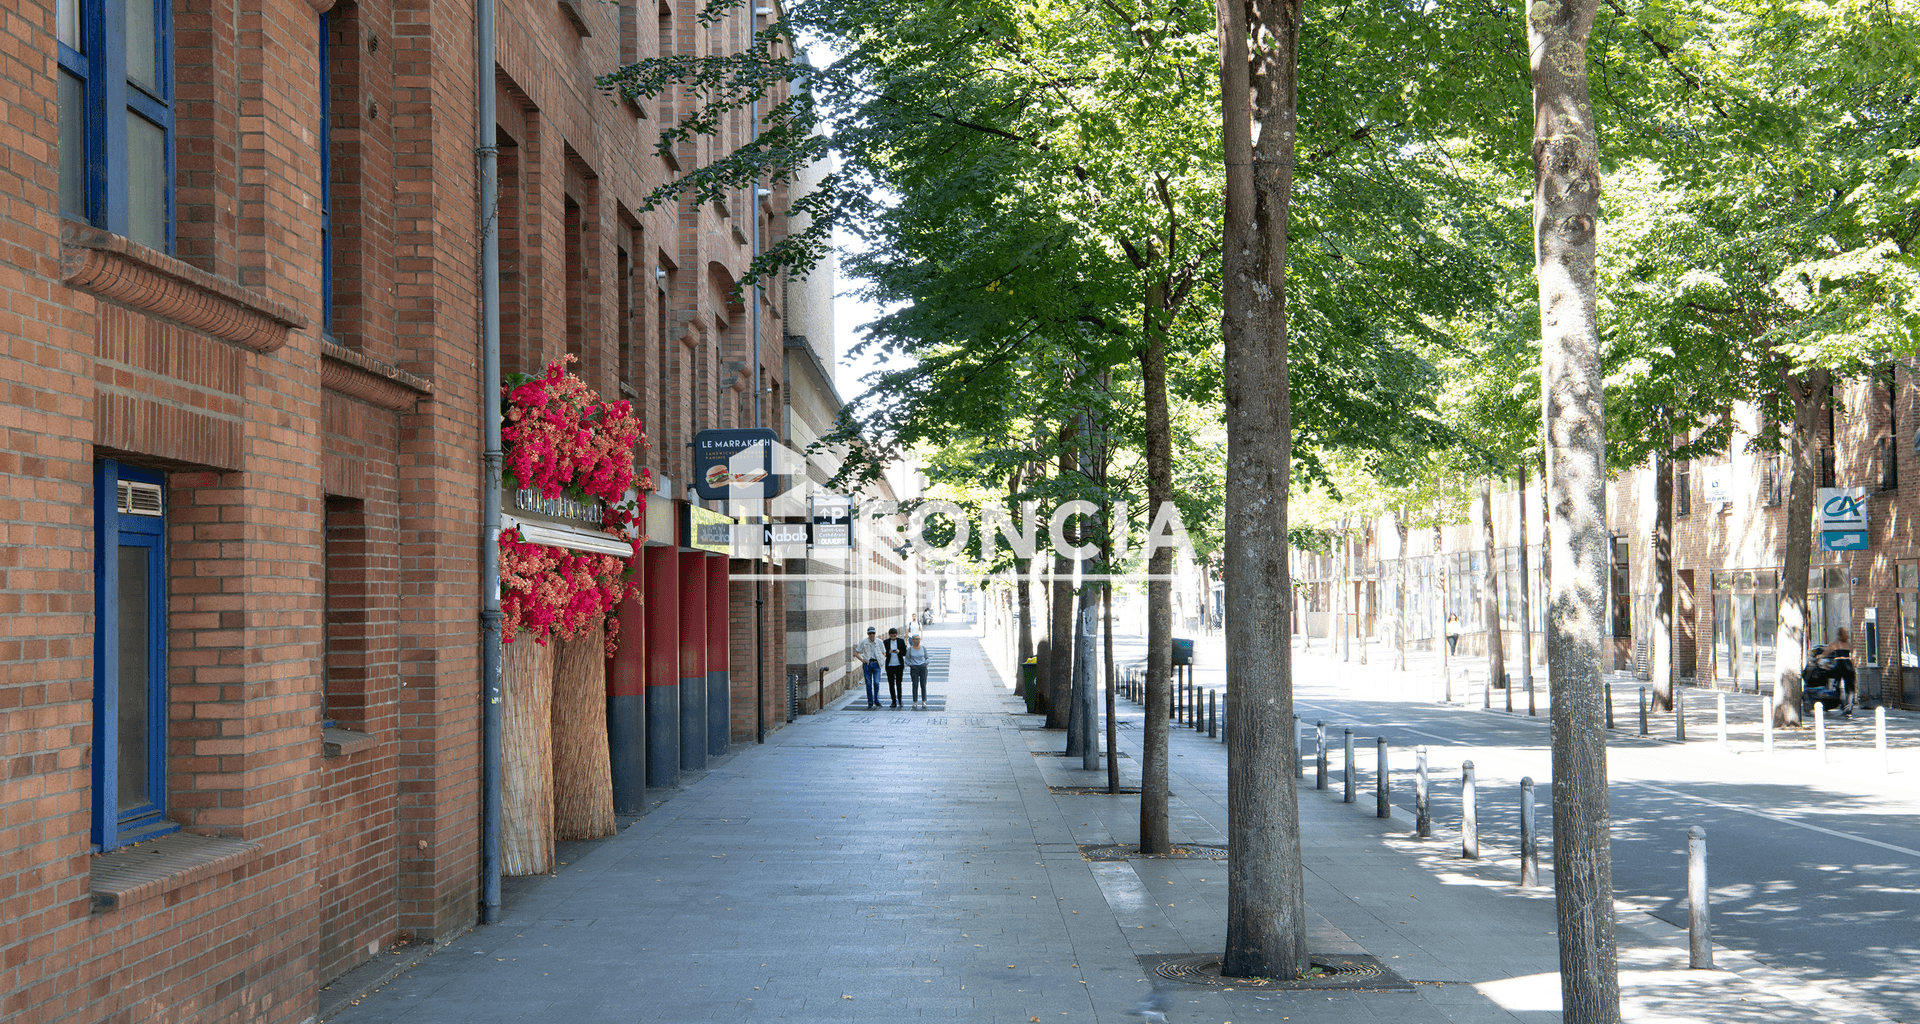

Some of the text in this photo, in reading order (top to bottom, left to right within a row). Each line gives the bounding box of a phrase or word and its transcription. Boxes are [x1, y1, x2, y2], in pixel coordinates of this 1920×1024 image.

[702, 439, 770, 448] LE MARRAKECH
[831, 506, 845, 525] P
[764, 526, 809, 542] Nabab
[820, 537, 846, 545] OUVERT
